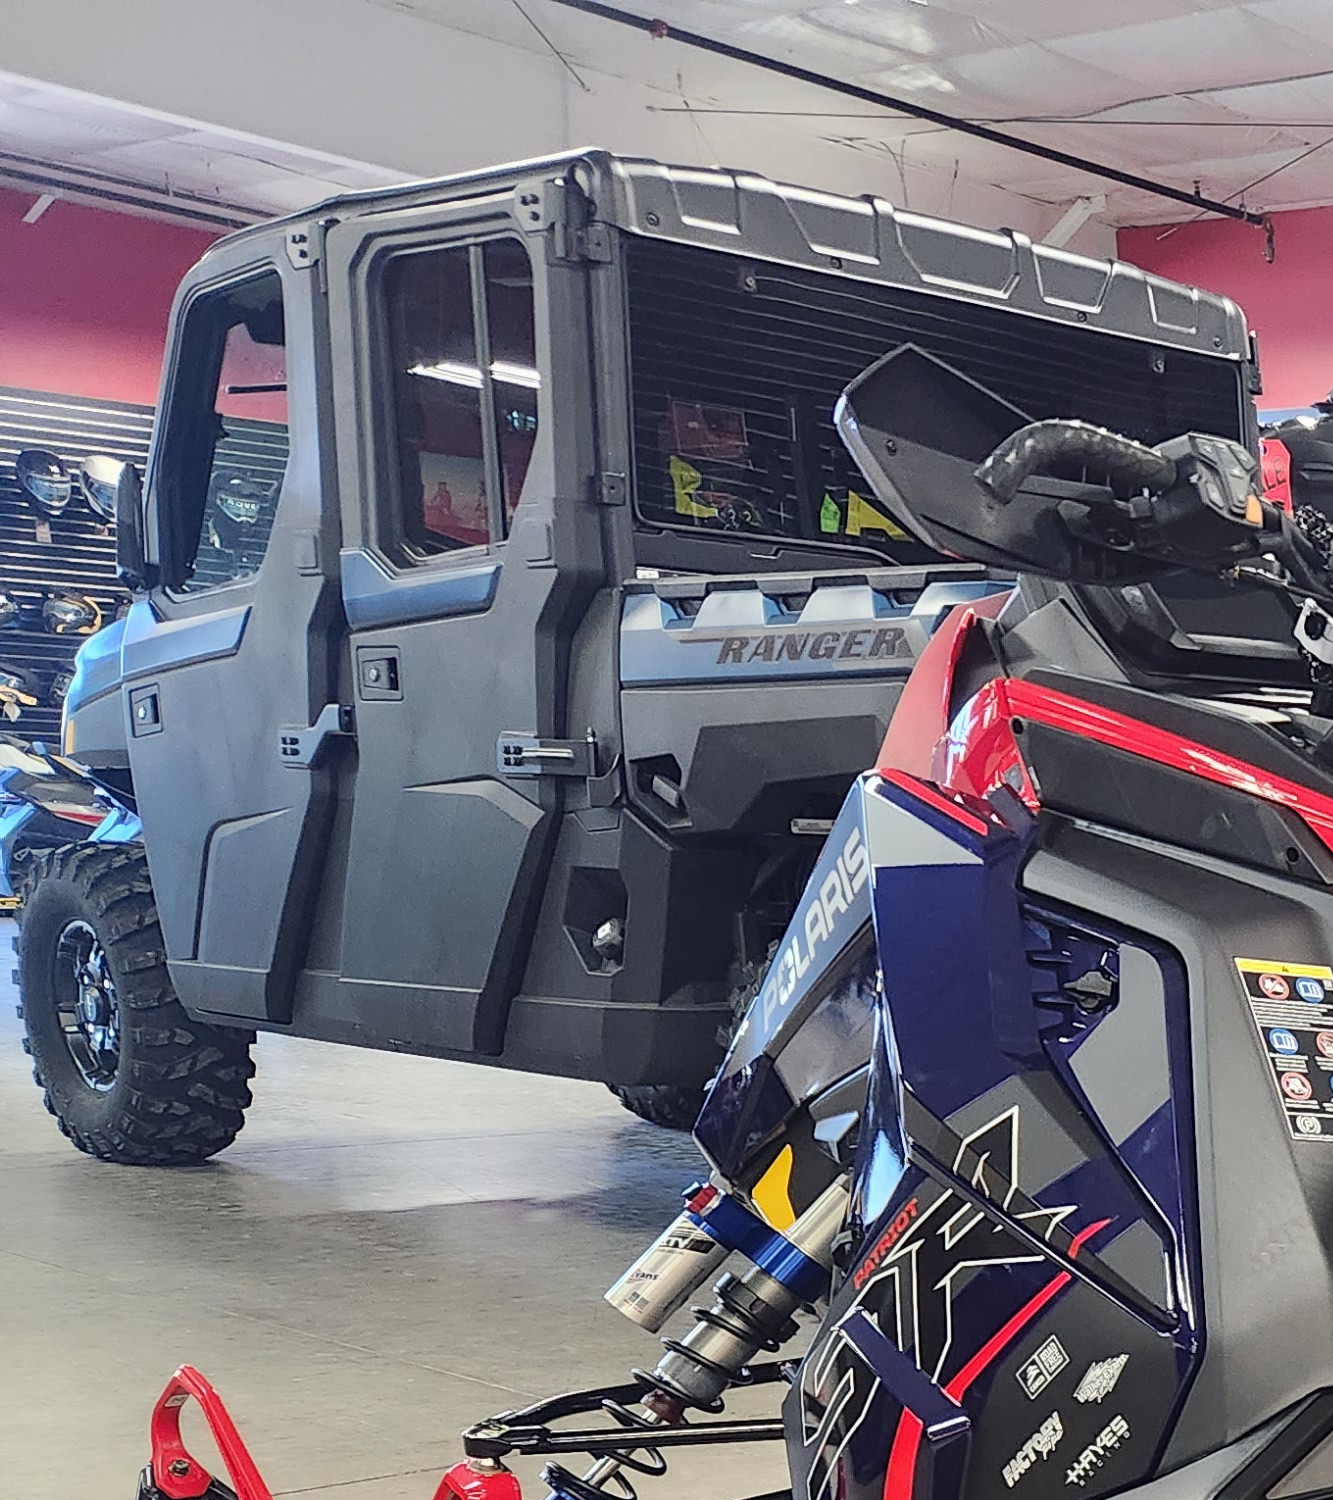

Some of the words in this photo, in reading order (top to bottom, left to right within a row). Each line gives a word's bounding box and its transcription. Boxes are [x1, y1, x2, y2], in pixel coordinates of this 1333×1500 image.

[716, 626, 915, 665] RANGER
[763, 826, 869, 1034] POLARIS
[854, 1197, 918, 1290] PATRIOT
[1002, 1410, 1064, 1488] FACTORY
[1065, 1414, 1129, 1485] HAYES
